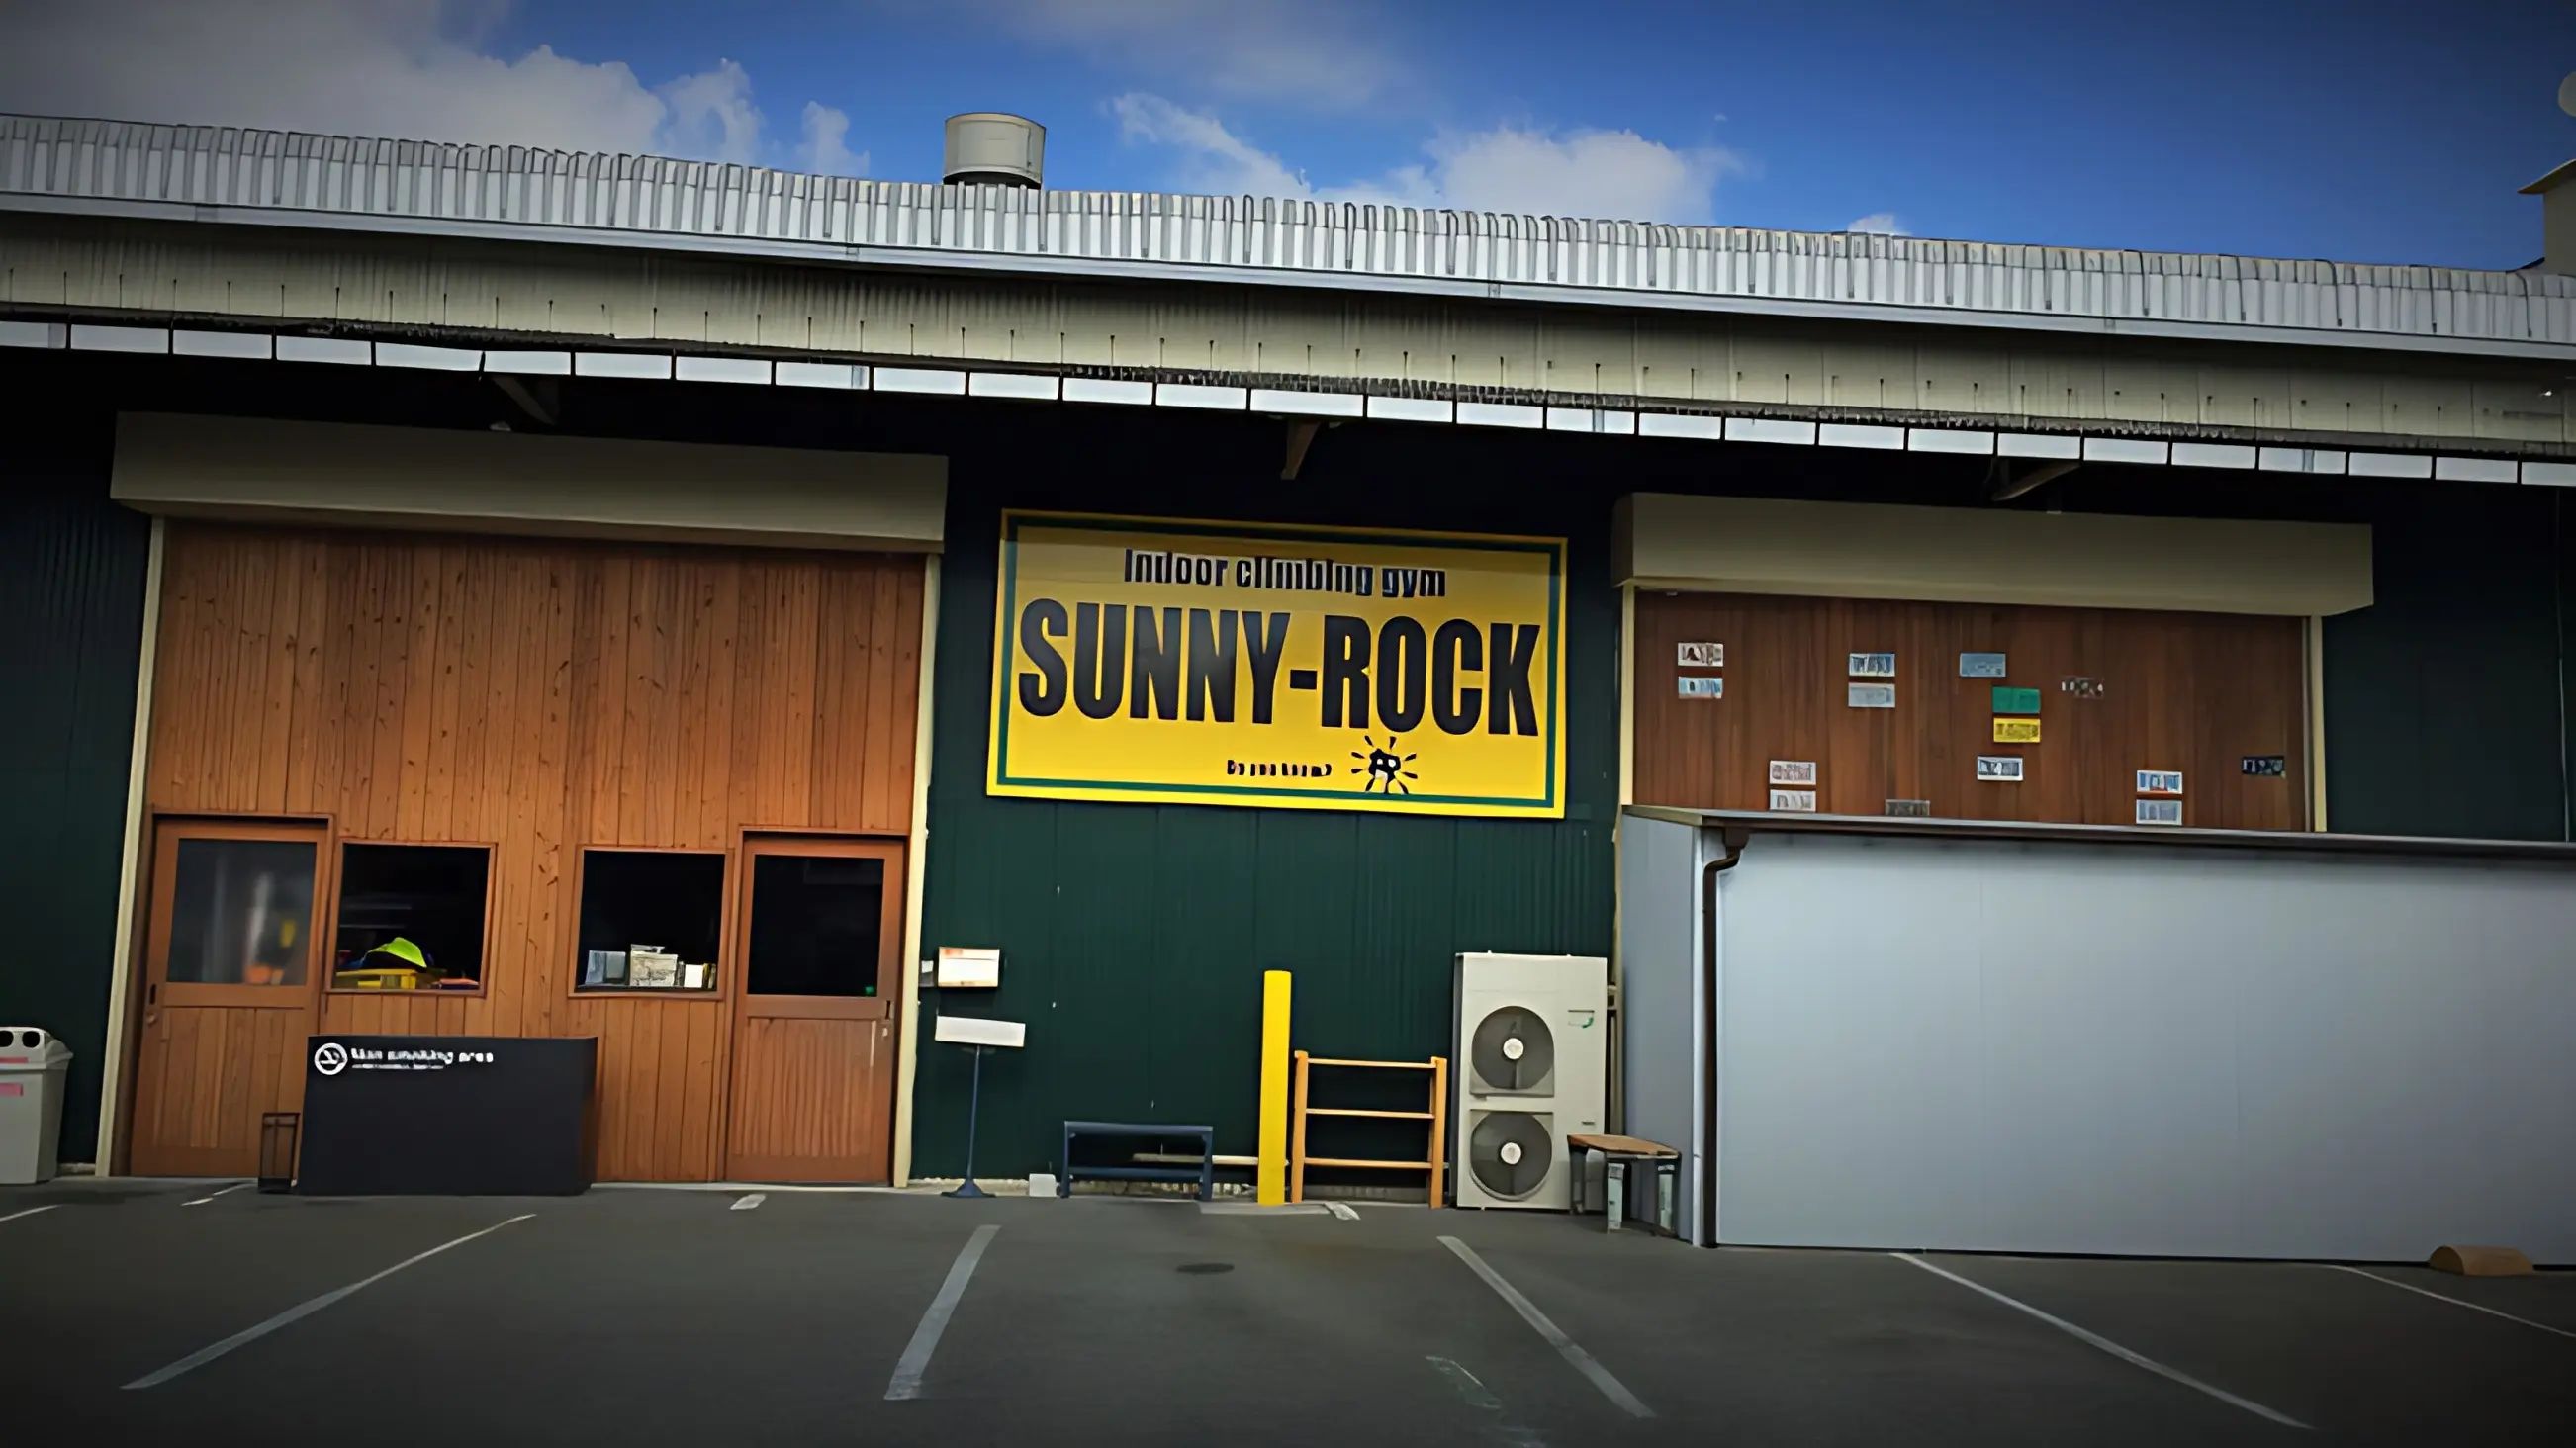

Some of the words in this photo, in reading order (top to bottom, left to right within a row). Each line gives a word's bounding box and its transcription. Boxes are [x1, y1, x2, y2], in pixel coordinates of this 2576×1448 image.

[1124, 549, 1228, 587] Indoor
[1237, 555, 1373, 596] climbing
[1382, 567, 1445, 597] gym
[1018, 598, 1540, 737] SUNNY-ROCK
